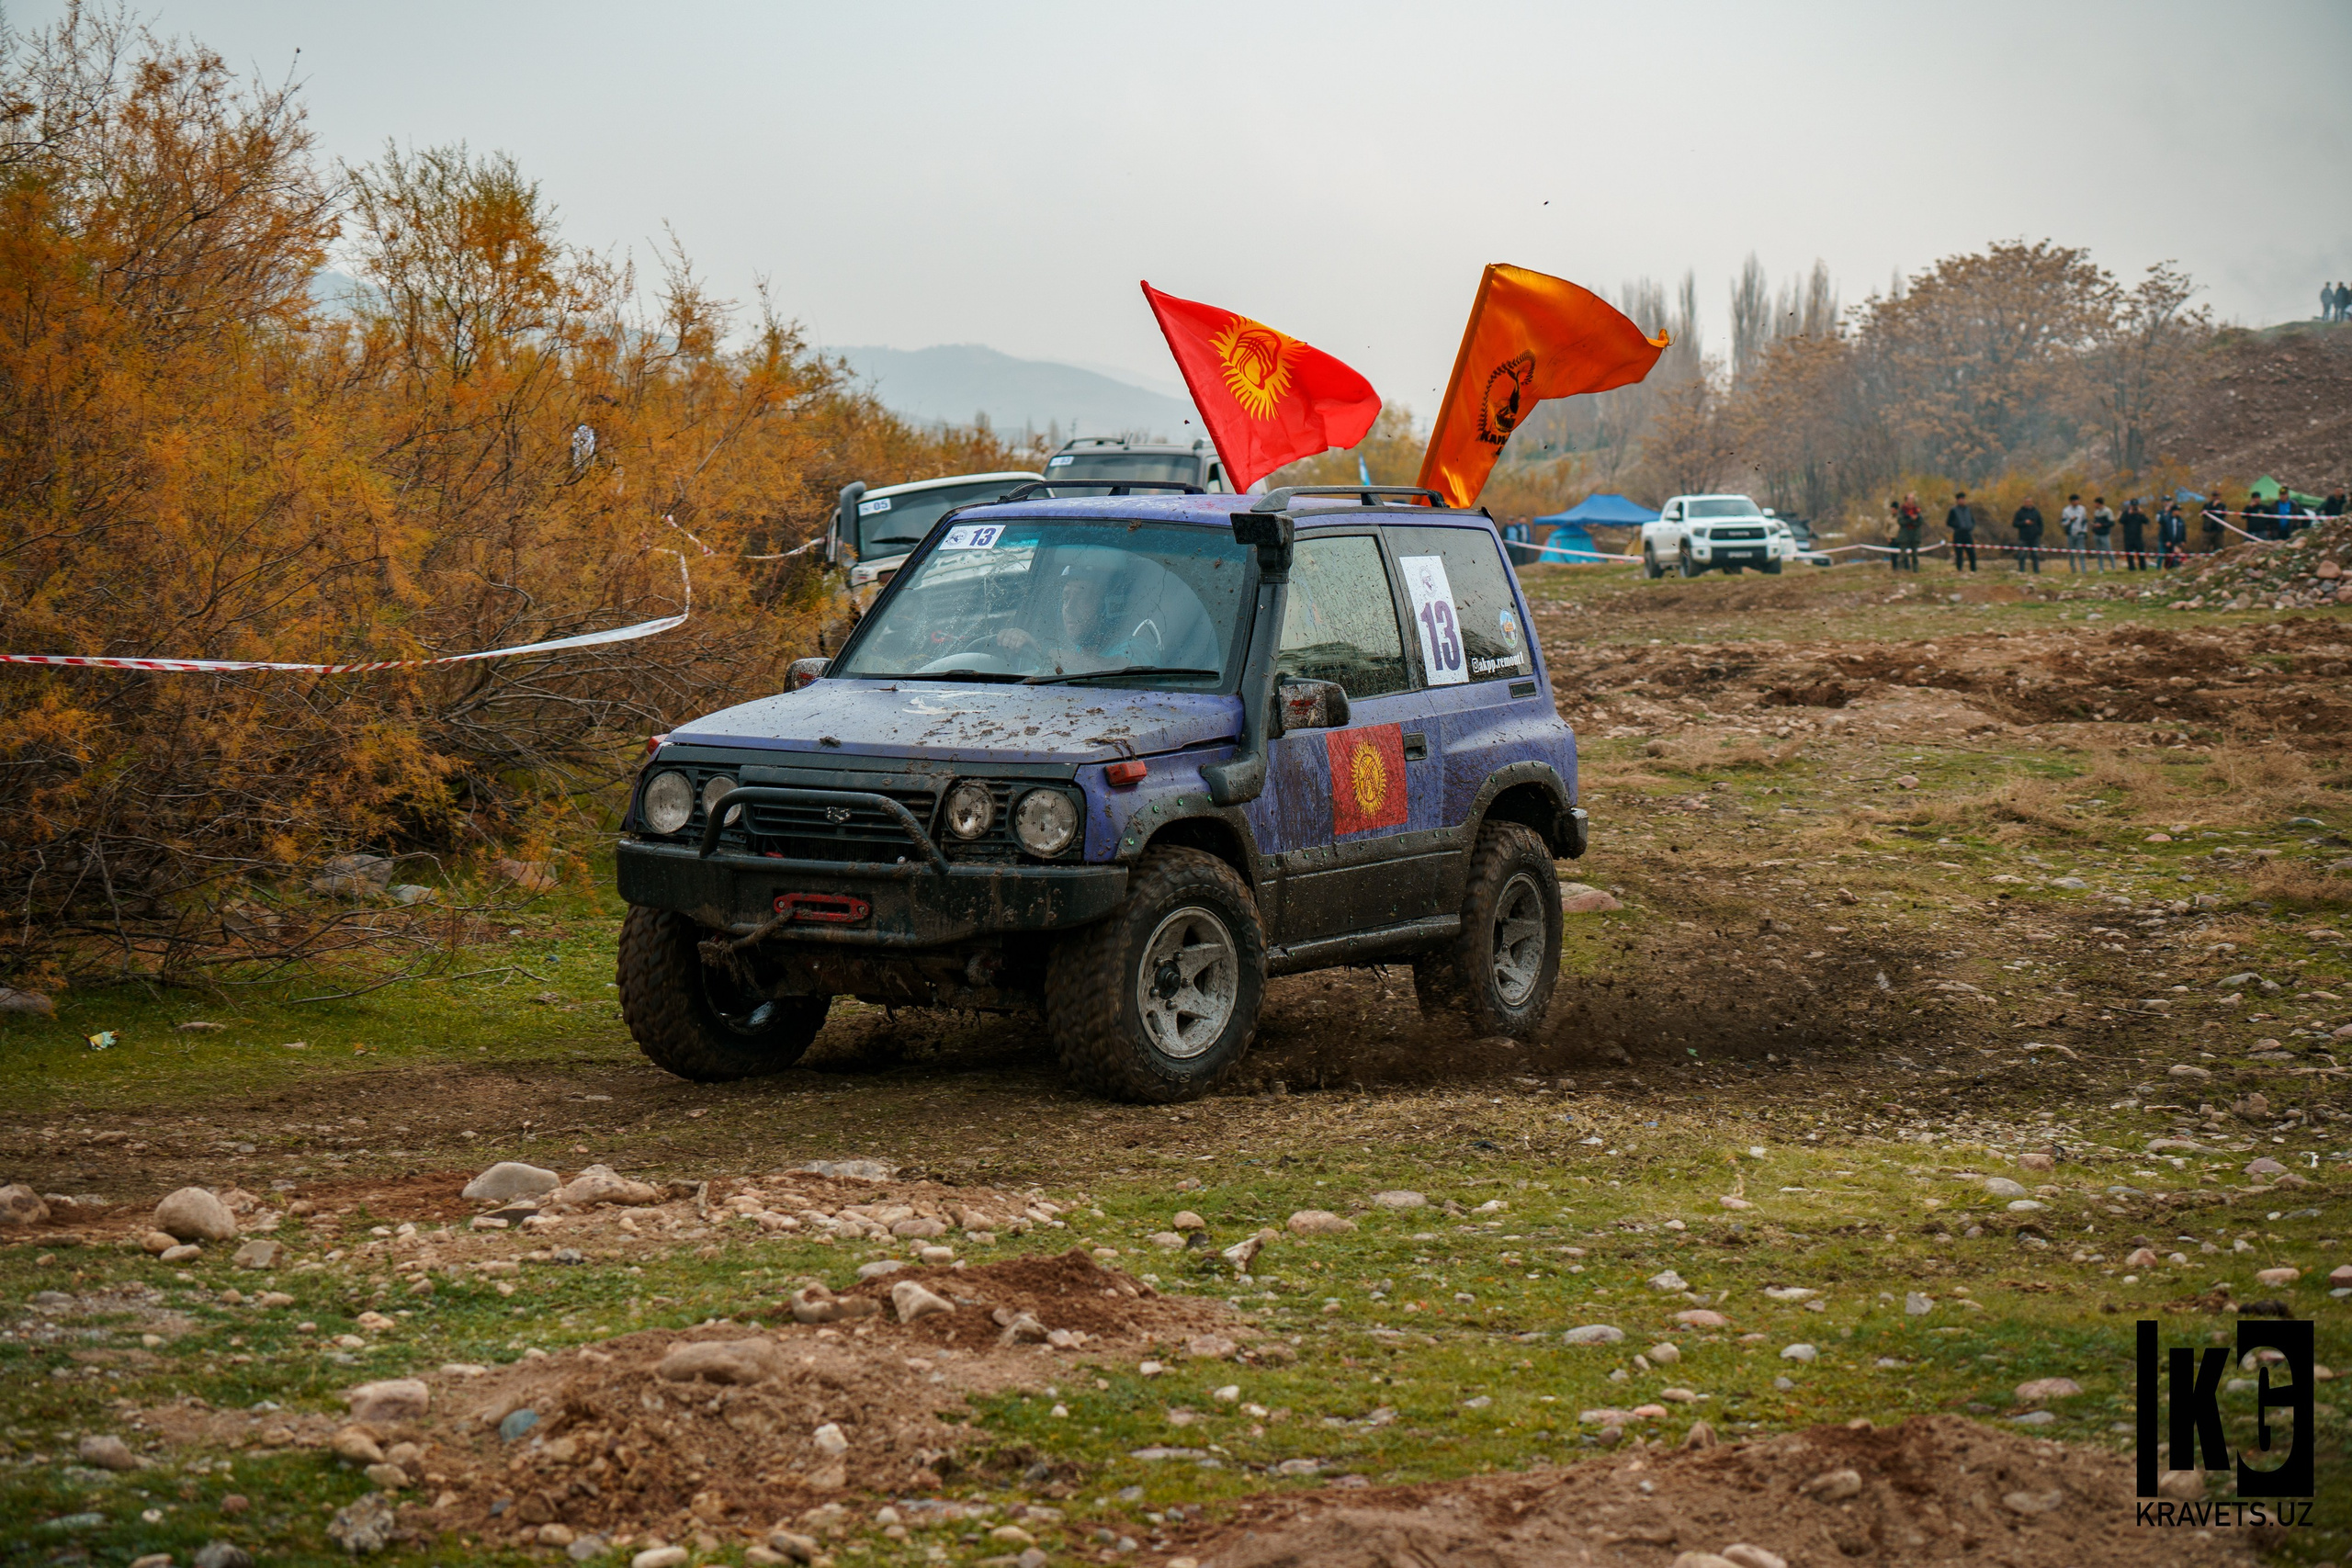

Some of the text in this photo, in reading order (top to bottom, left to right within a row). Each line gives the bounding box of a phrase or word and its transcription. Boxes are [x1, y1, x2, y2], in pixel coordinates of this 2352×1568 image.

[874, 501, 888, 511] 05
[969, 527, 997, 547] 13
[1420, 600, 1461, 671] 13
